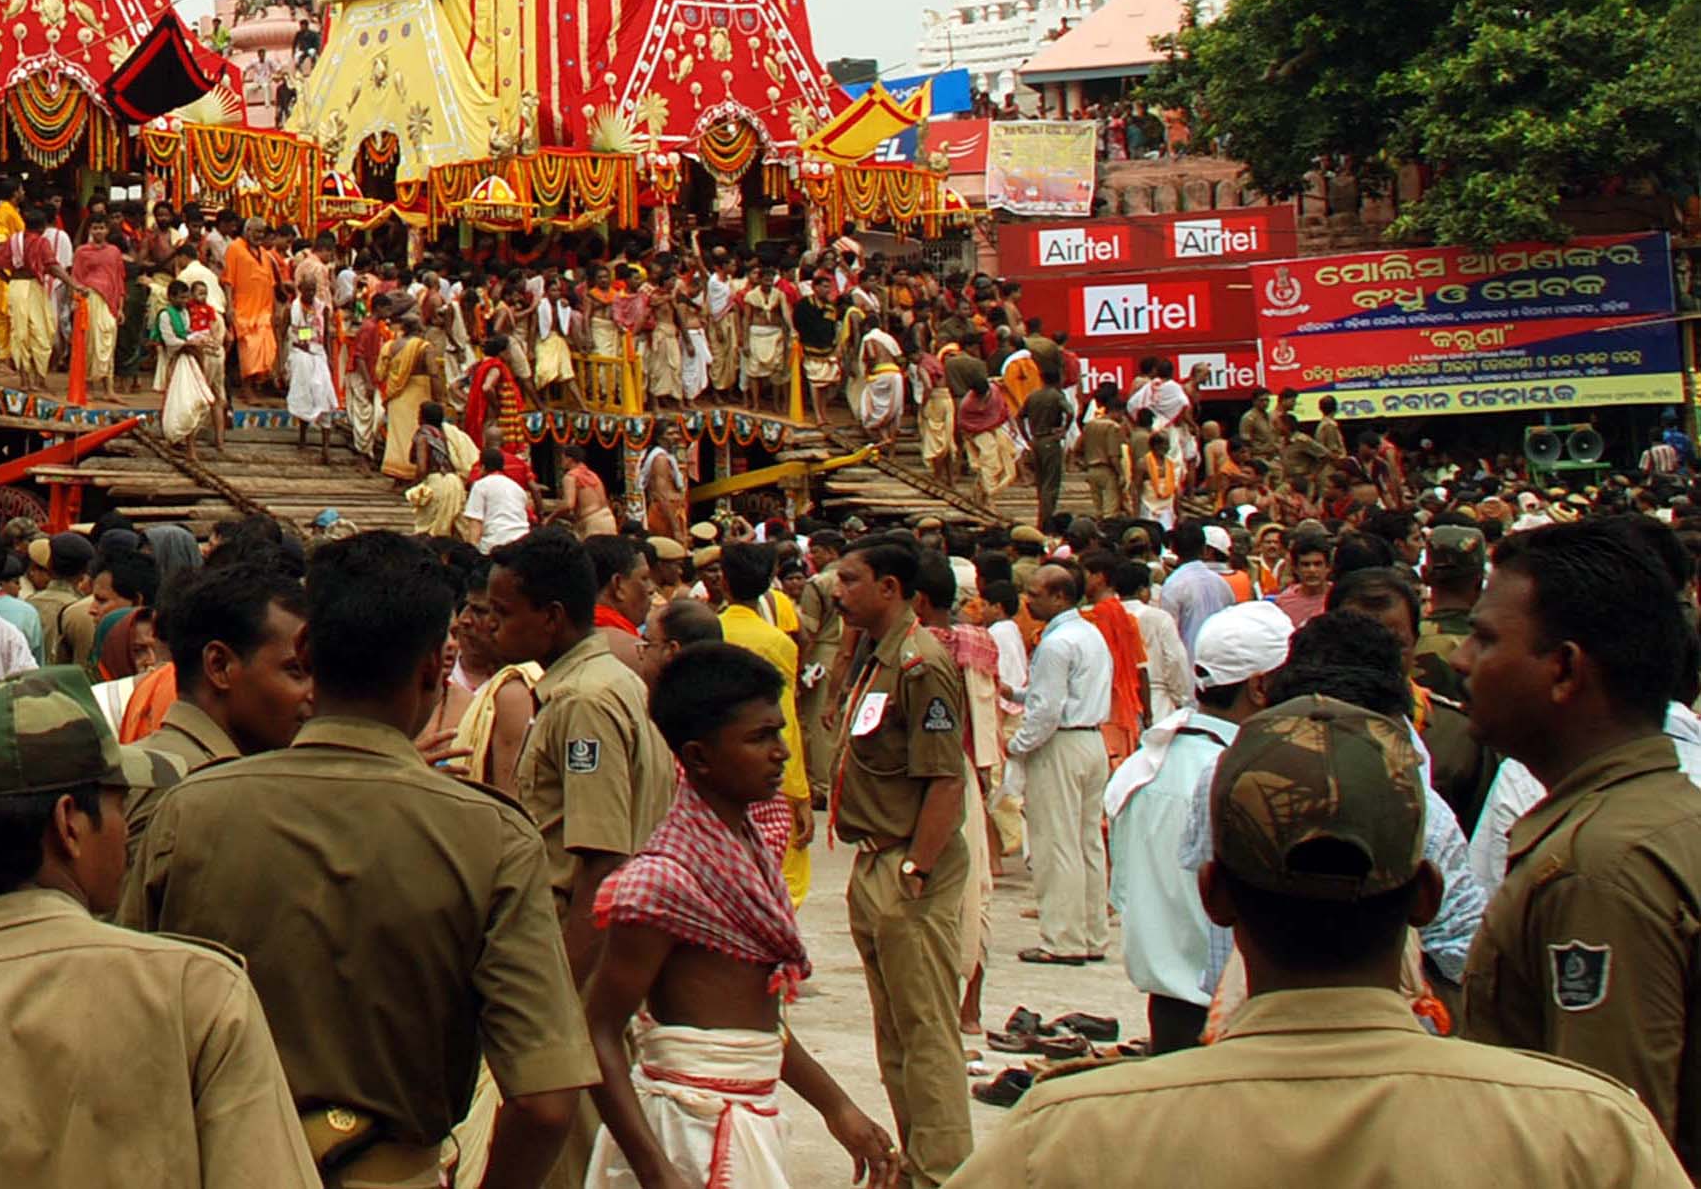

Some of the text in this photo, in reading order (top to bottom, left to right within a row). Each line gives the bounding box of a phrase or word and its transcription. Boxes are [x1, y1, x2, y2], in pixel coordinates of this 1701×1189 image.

[874, 137, 907, 163] EL
[1045, 234, 1120, 262] Airtel
[1180, 225, 1258, 255] Airtel
[1314, 253, 1447, 287] ପୋଲିସ
[1436, 283, 1470, 304] ଓ
[1480, 274, 1607, 302] ସେବକ
[1091, 294, 1197, 332] Airtel
[1199, 361, 1261, 388] irtel
[1381, 390, 1451, 413] ନବୀନ
